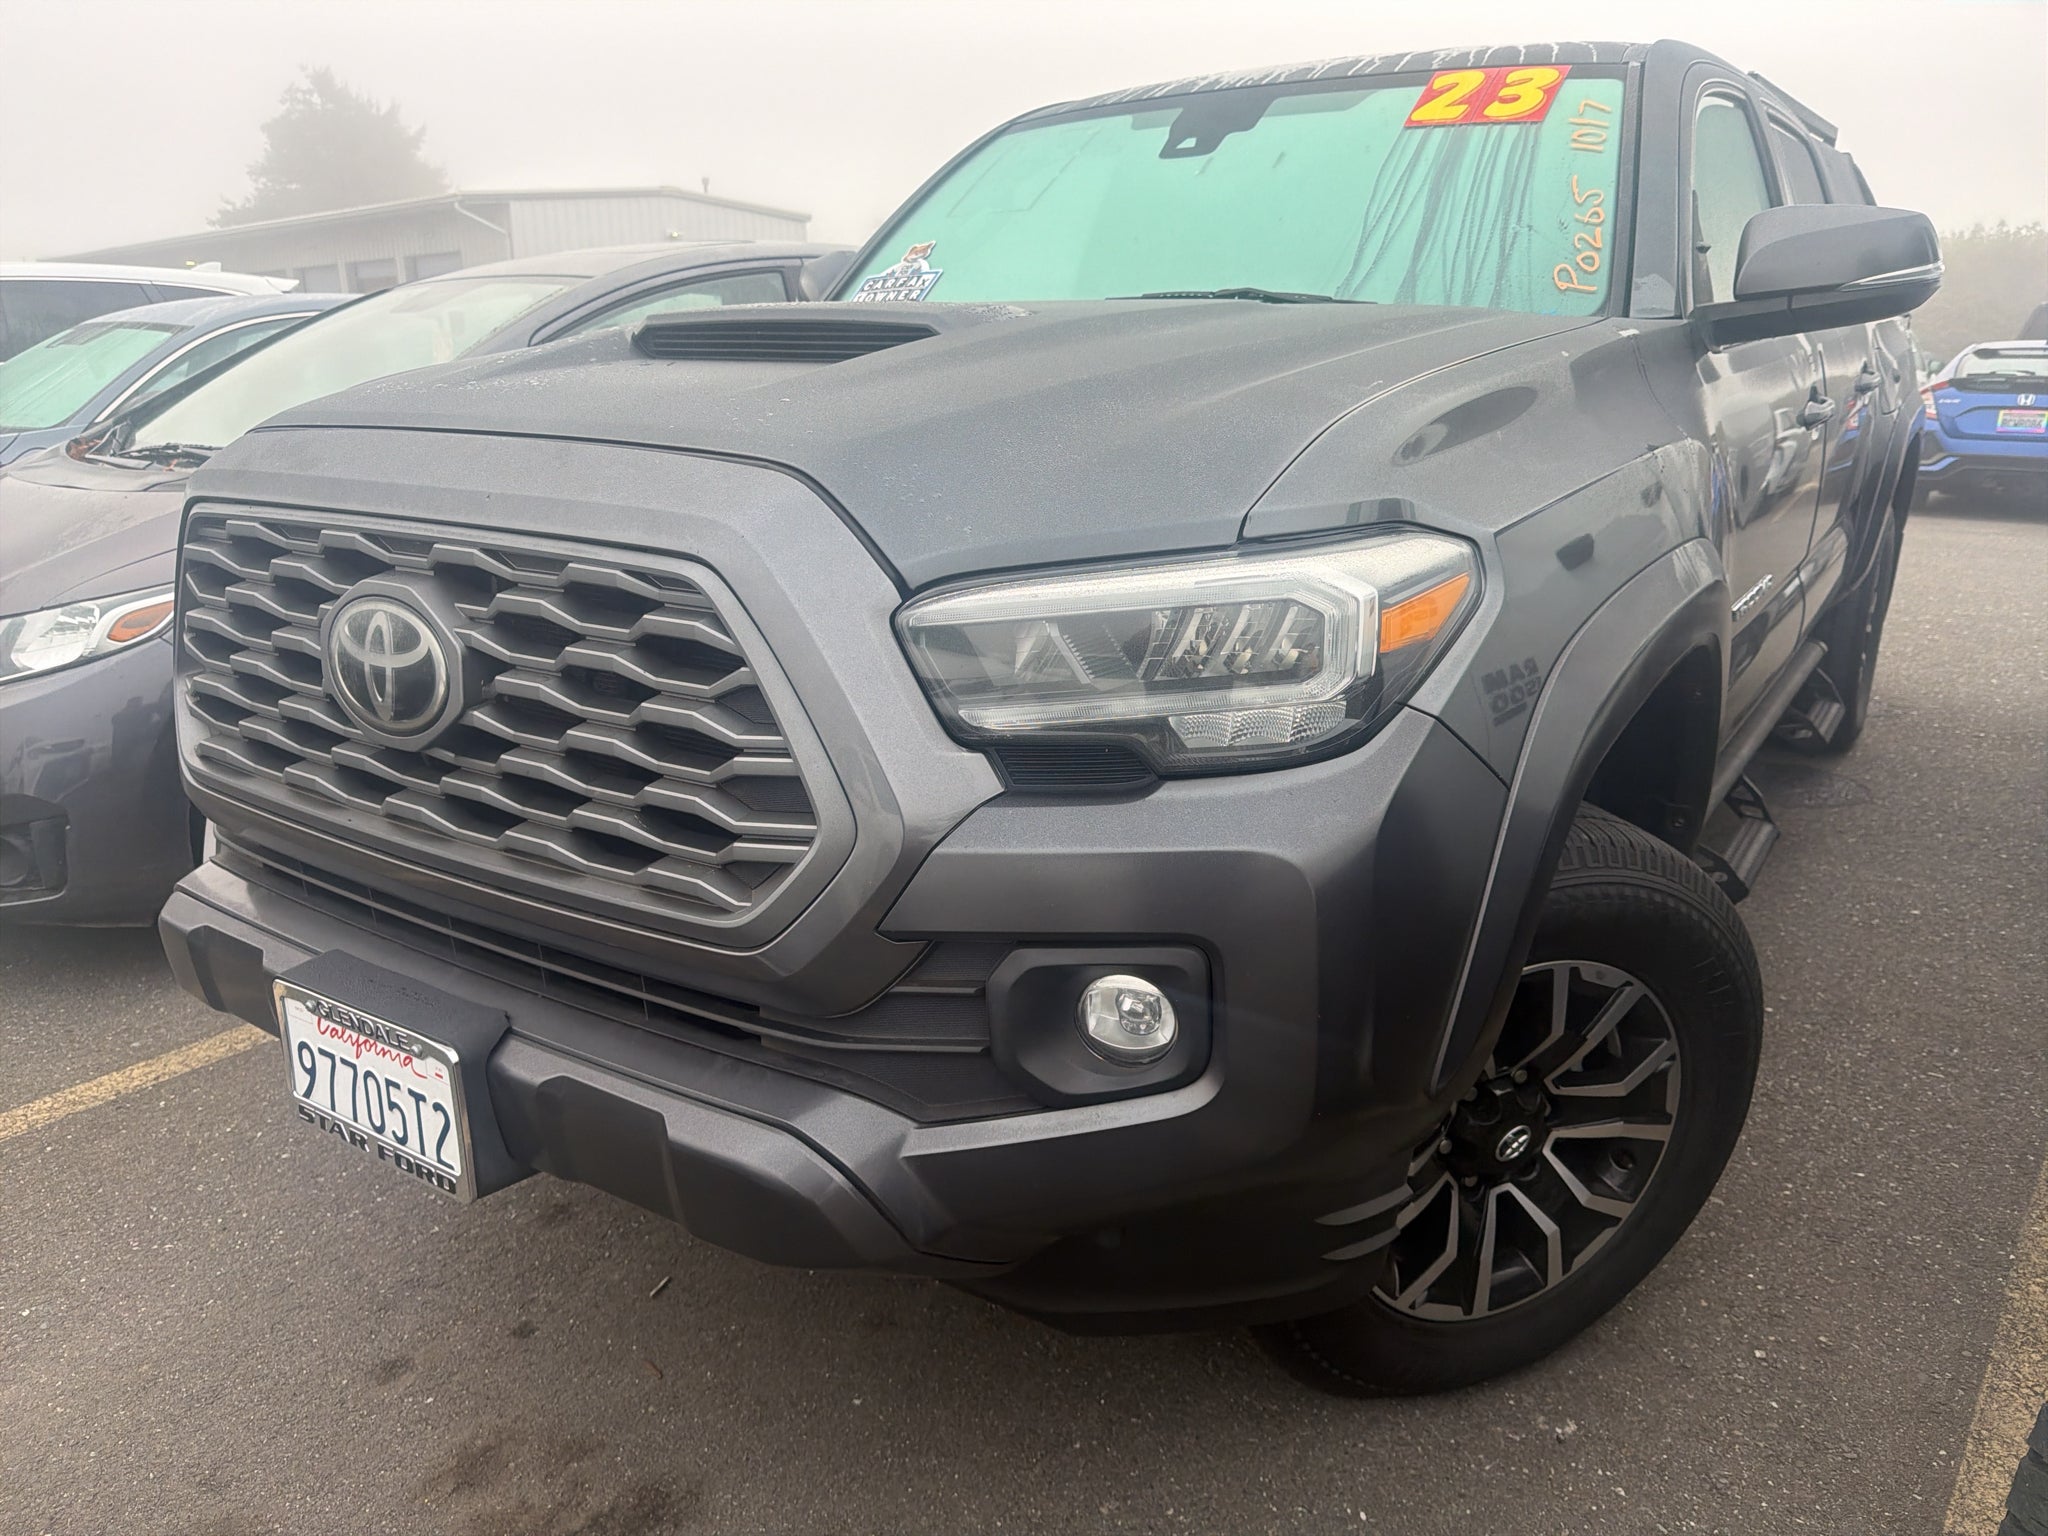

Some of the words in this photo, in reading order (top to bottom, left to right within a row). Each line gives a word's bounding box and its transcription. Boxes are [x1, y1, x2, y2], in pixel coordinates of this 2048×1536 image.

[1410, 67, 1561, 122] 23
[863, 275, 930, 291] CARFAX
[316, 999, 411, 1051] GLENDALE
[297, 1040, 455, 1172] 97705T2
[298, 1102, 370, 1152] STAR
[377, 1141, 457, 1195] FORD
